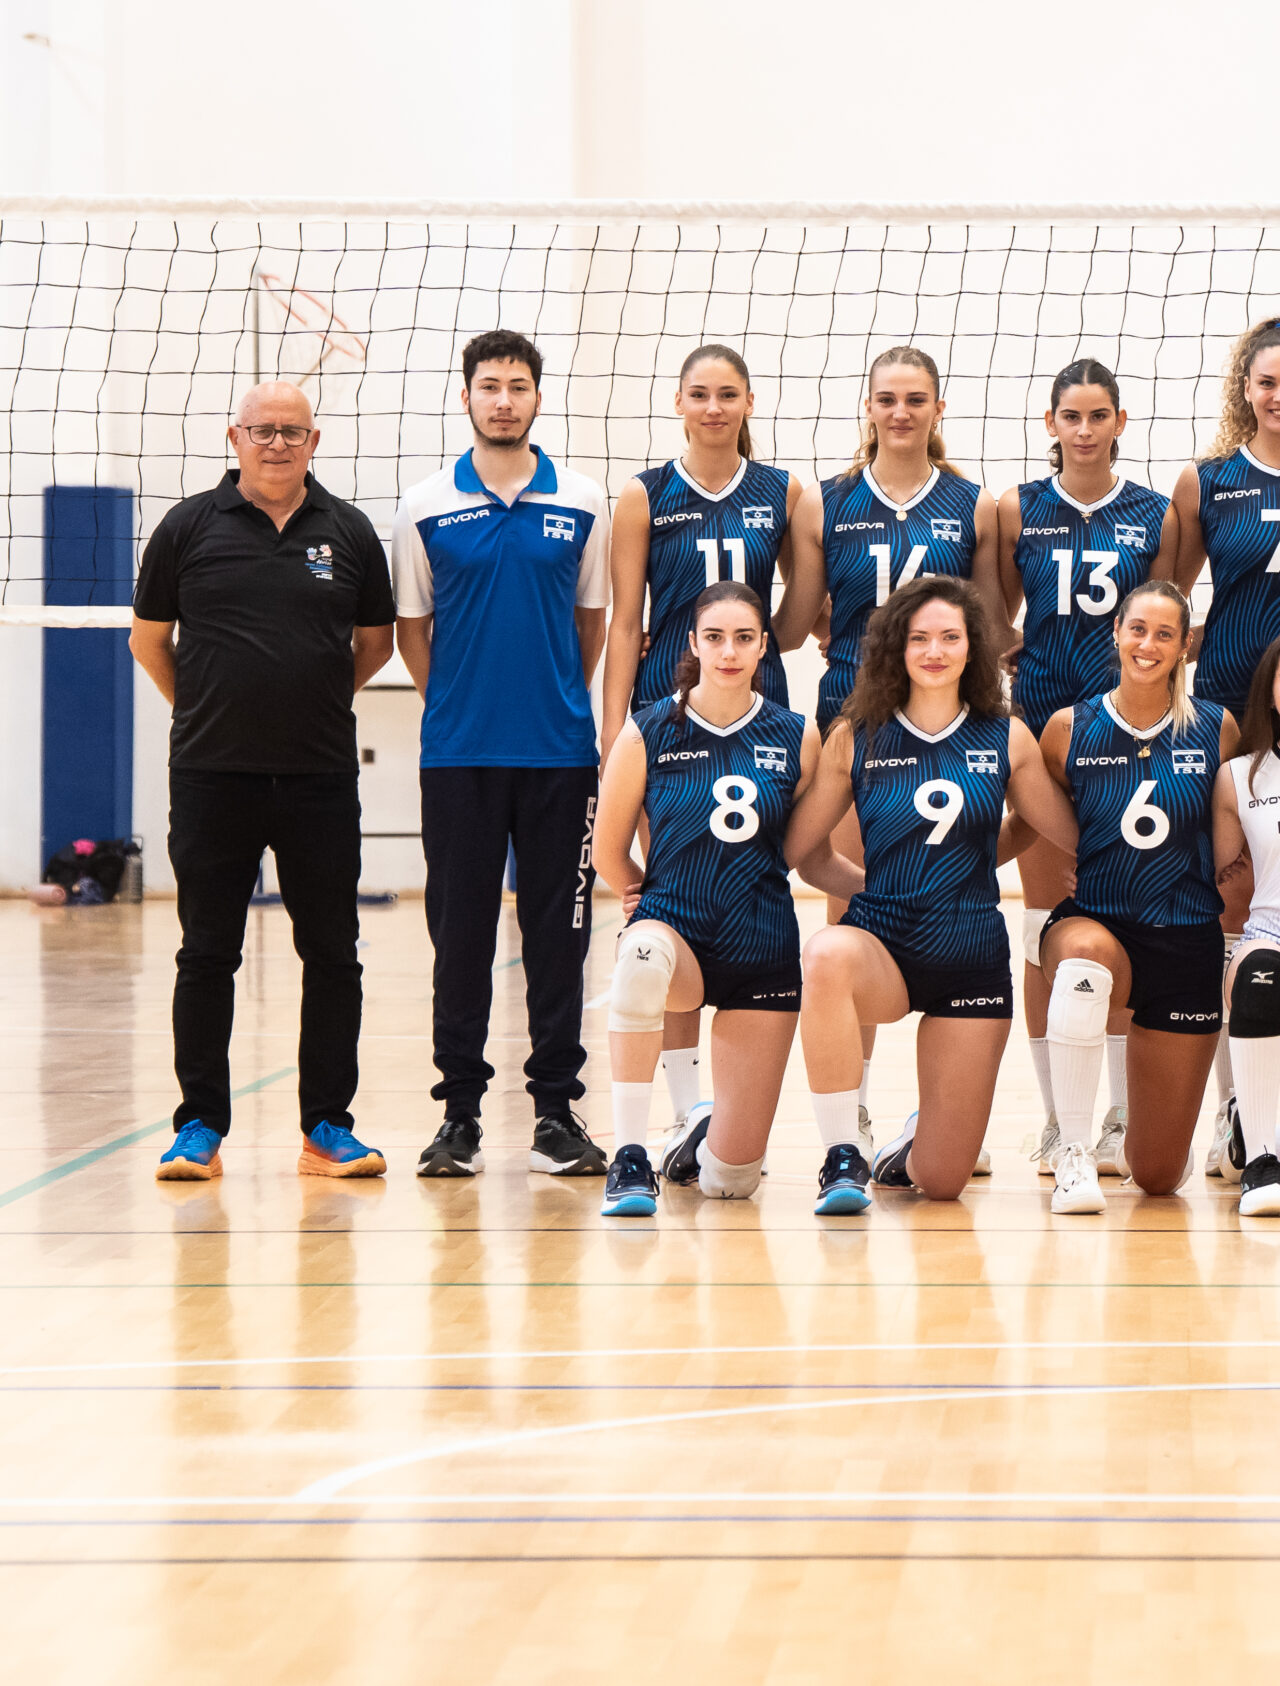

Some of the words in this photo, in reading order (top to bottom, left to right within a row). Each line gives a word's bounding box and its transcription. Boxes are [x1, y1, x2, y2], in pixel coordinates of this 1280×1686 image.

[1214, 489, 1261, 501] GIVOVA
[437, 509, 490, 527] GIVOVA
[653, 512, 703, 526] GIVOVA
[744, 521, 775, 530] ISR
[834, 522, 885, 532] GIVOVA
[1022, 526, 1070, 536] GIVOVA
[543, 531, 574, 542] ISR
[696, 538, 746, 587] 11
[1052, 549, 1119, 616] 13
[657, 750, 709, 764] GIVOVA
[864, 757, 918, 769] GIVOVA
[1076, 756, 1128, 767] GIVOVA
[755, 762, 787, 773] ISR
[968, 767, 999, 775] ISR
[1173, 767, 1207, 775] ISR
[709, 775, 760, 843] 8
[913, 779, 965, 845] 9
[1120, 780, 1170, 850] 6
[572, 796, 597, 929] GIVOVA
[951, 997, 1004, 1007] GIVOVA
[1170, 1012, 1219, 1021] GIVOVA
